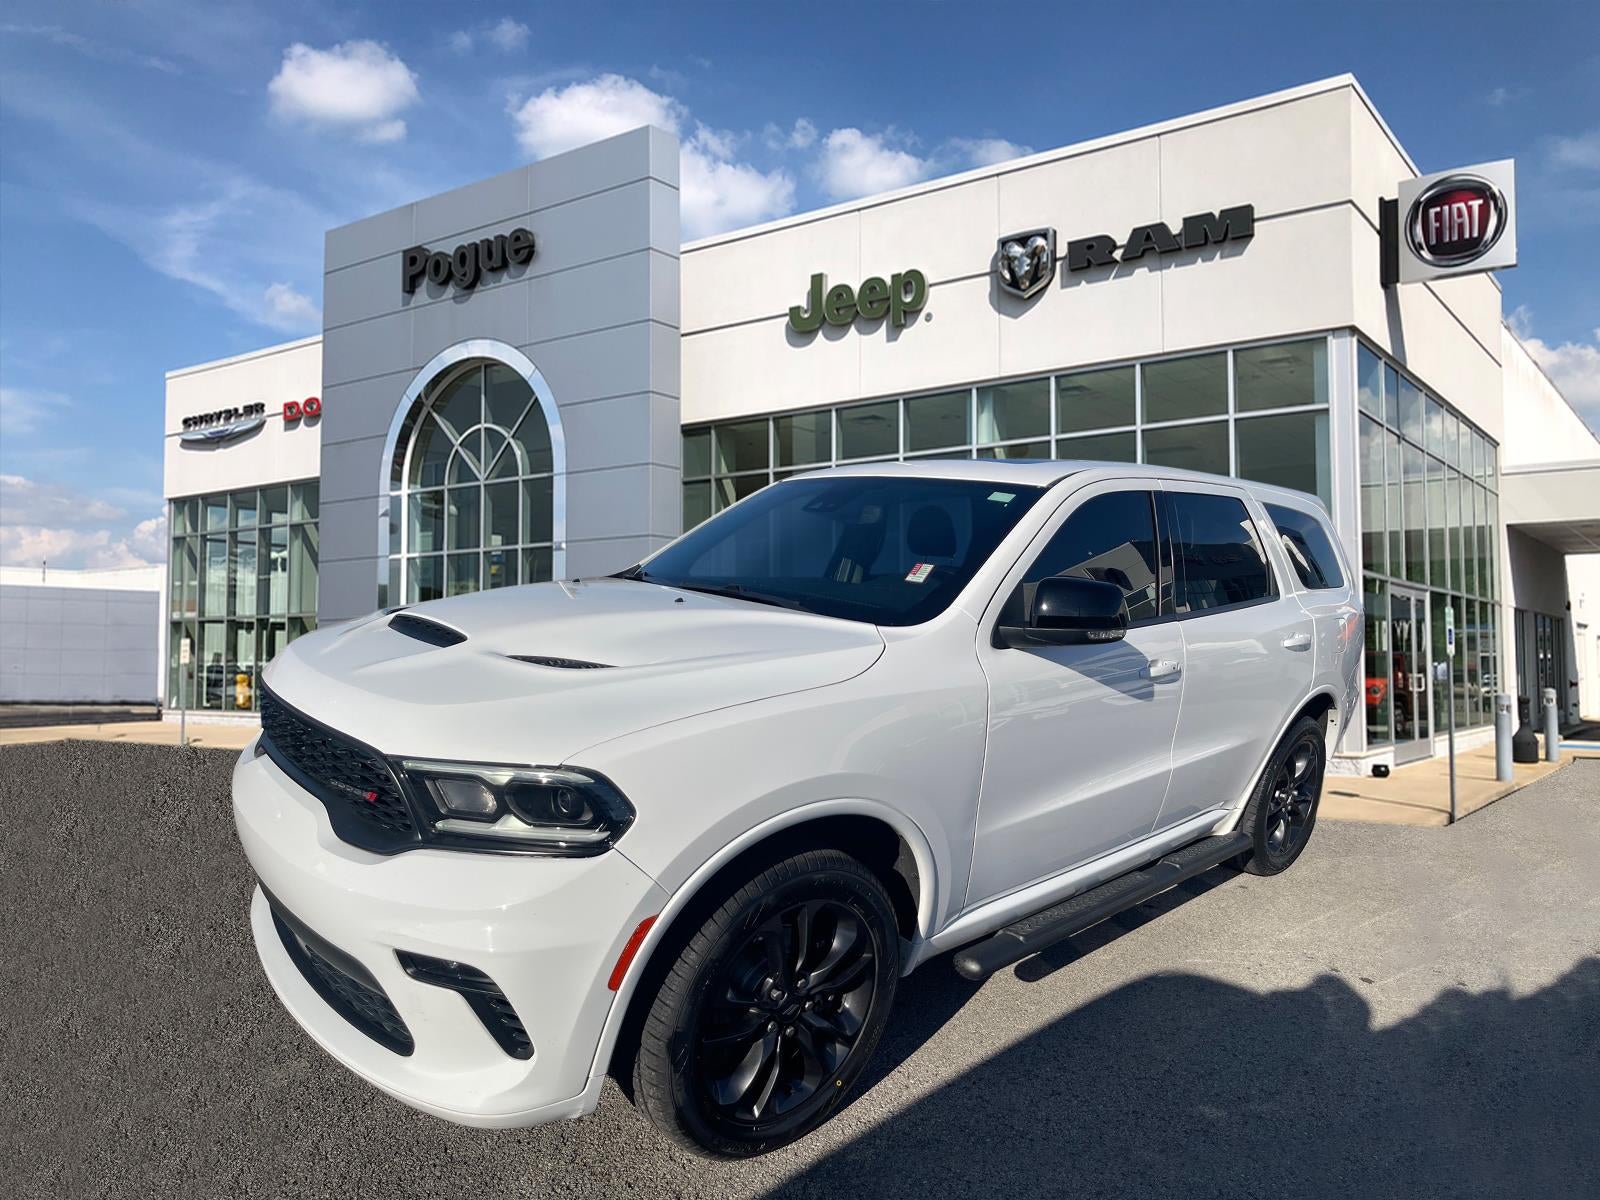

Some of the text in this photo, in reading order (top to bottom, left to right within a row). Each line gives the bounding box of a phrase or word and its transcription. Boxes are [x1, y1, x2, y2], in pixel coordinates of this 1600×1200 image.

[1066, 203, 1256, 272] RAM
[1428, 199, 1484, 246] FIAT
[402, 229, 535, 294] Pogue
[788, 268, 929, 333] Jeep
